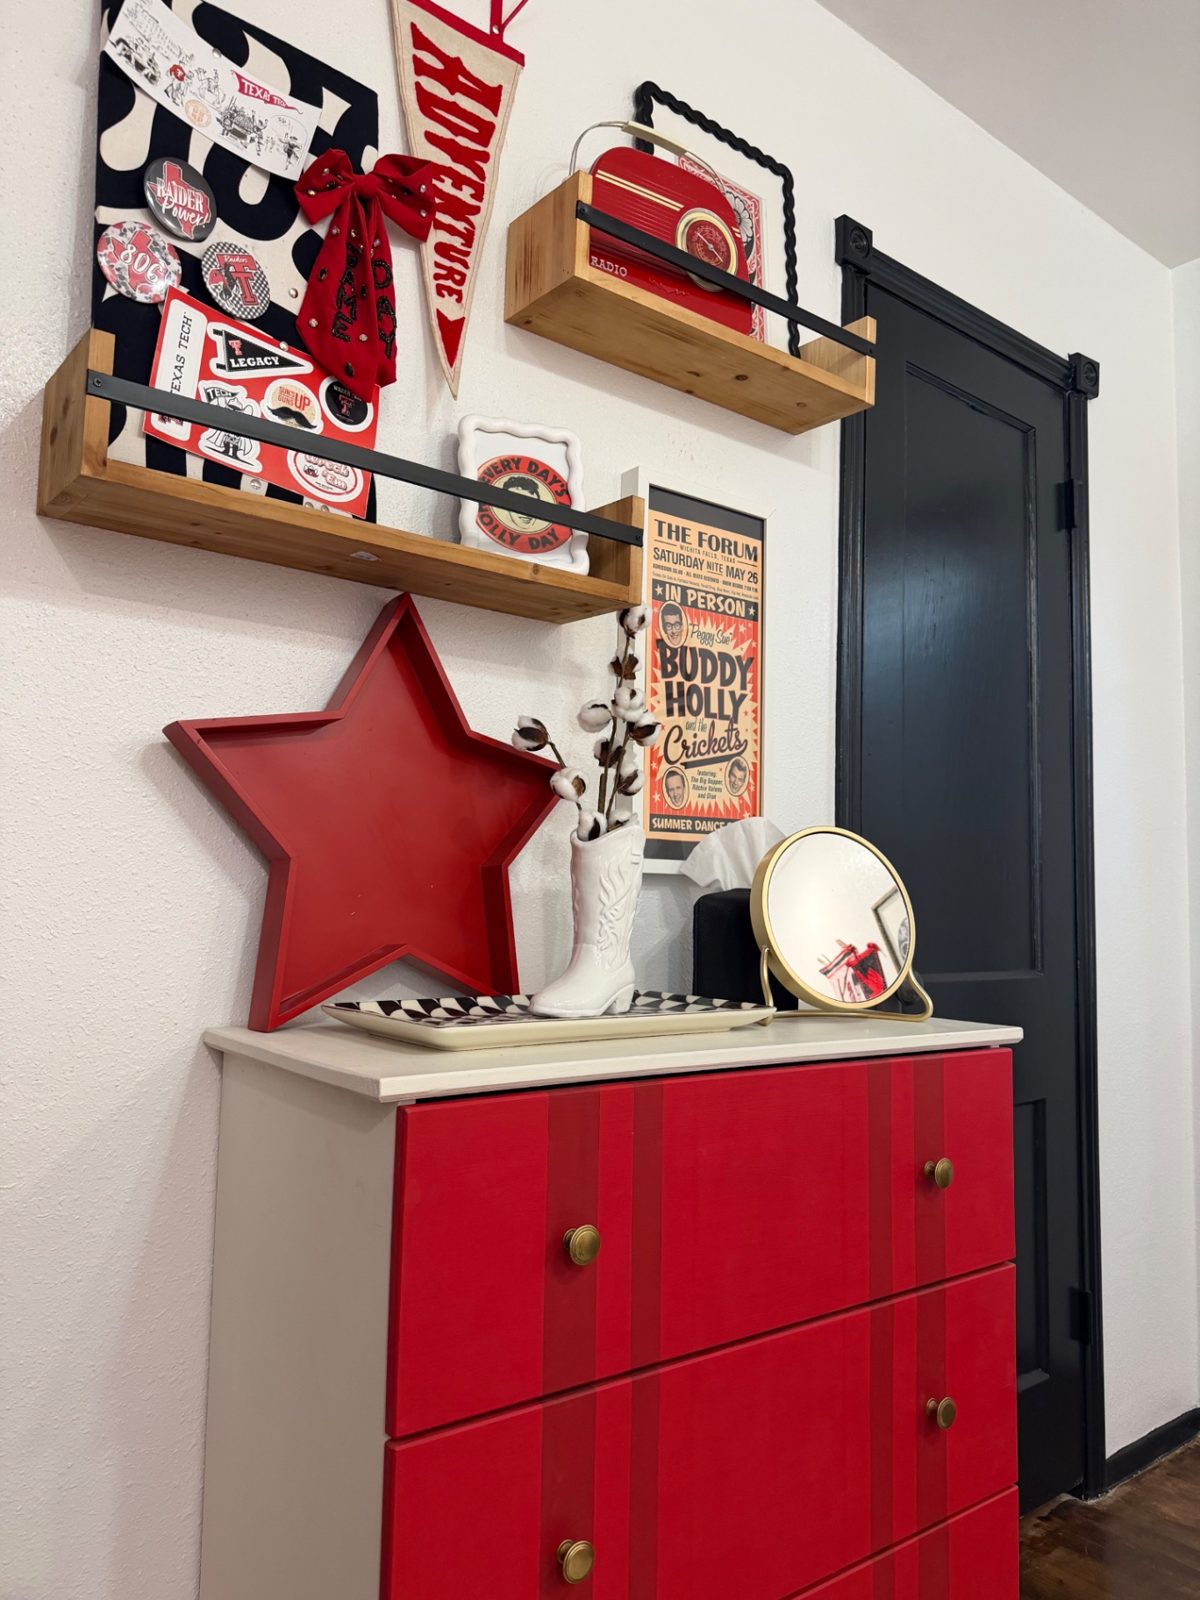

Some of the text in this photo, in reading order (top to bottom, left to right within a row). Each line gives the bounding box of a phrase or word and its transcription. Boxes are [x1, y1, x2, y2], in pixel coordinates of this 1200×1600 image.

[240, 78, 271, 102] TEXAS
[410, 21, 503, 304] ADVENTURE
[156, 178, 204, 213] RAIDER
[161, 195, 209, 228] Power!
[223, 255, 248, 264] Raiders
[591, 256, 628, 277] RADIO
[372, 260, 397, 359] DAY
[178, 314, 192, 350] TECH
[229, 356, 280, 368] LEGACY
[206, 387, 232, 400] TECH
[294, 392, 311, 411] UP
[528, 528, 559, 550] DAY
[653, 518, 758, 562] THE FORUM
[653, 547, 705, 571] SATURDAY
[706, 560, 724, 573] NITE
[726, 565, 746, 581] MAY
[747, 571, 758, 584] 26
[665, 584, 682, 603] IN
[686, 589, 745, 617] PERSON
[656, 638, 754, 691] BUDDY
[664, 681, 748, 724] HOLLY
[663, 718, 748, 765] Crickets
[652, 817, 692, 831] SUMMER
